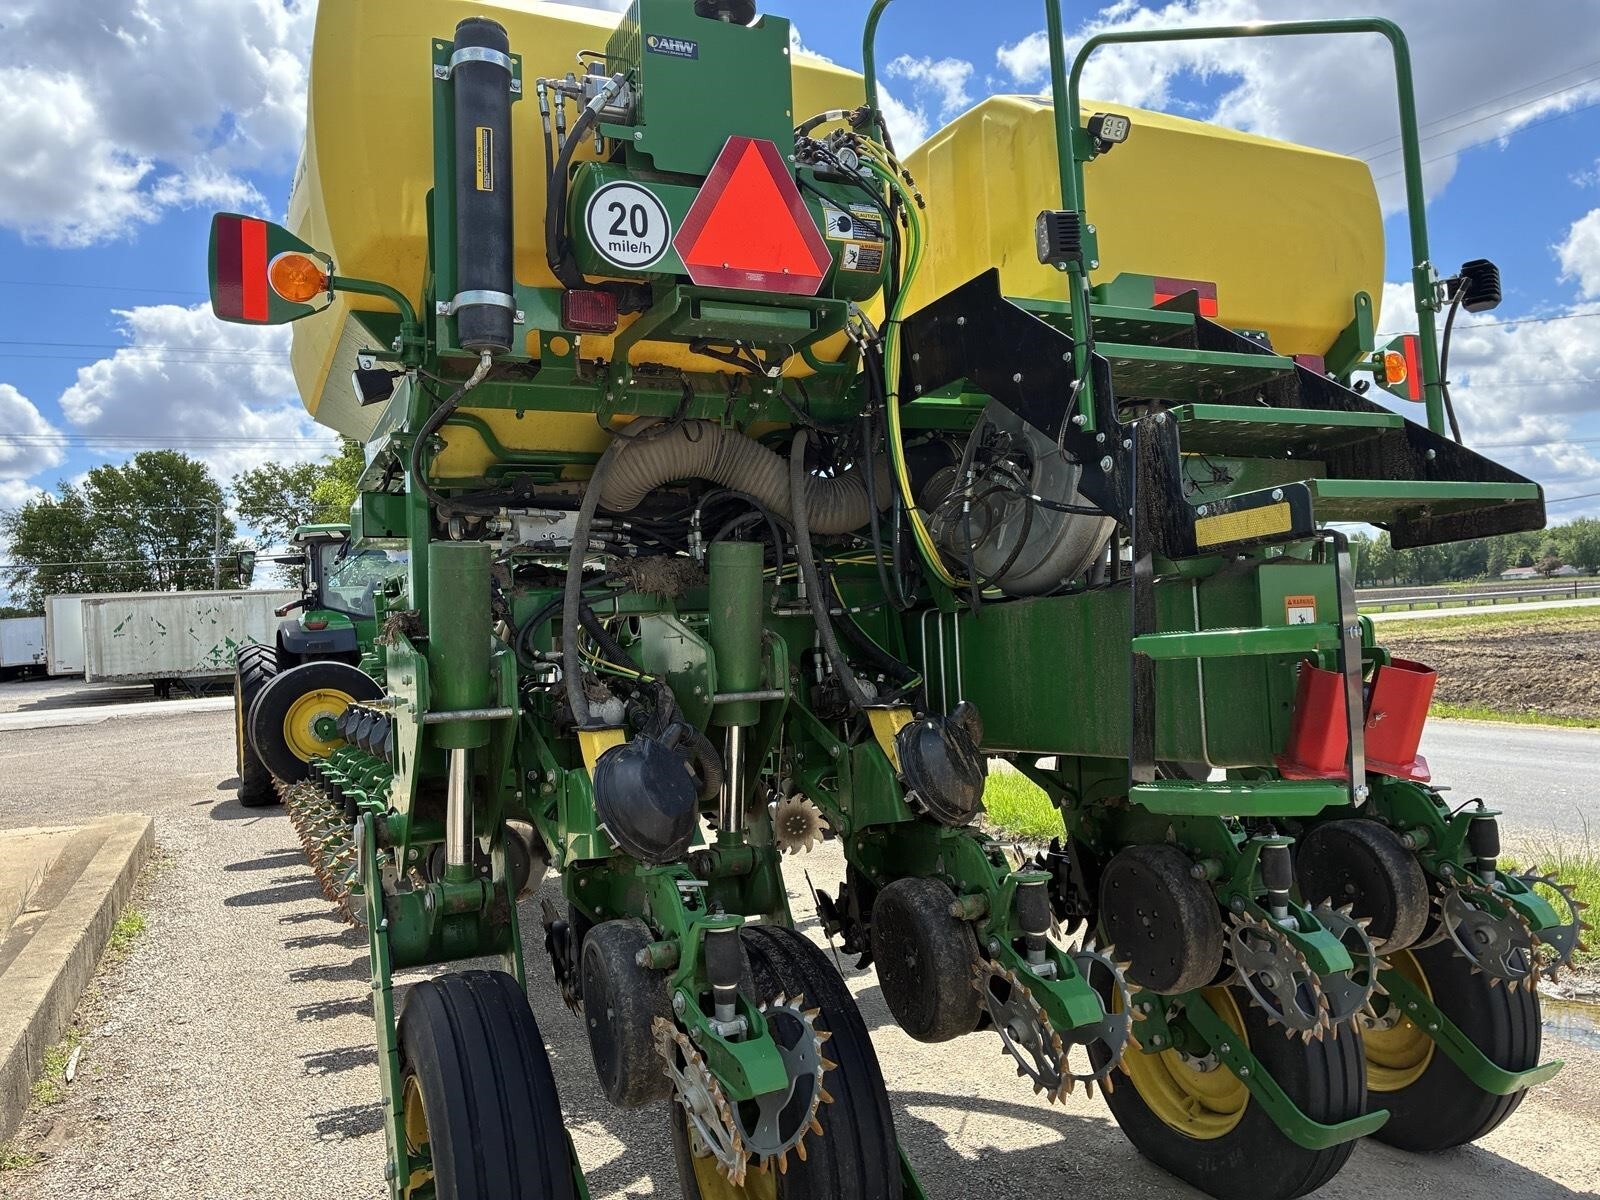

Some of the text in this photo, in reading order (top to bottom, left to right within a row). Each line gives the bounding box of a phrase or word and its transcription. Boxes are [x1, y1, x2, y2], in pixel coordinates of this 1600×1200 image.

[659, 38, 694, 53] AHW
[608, 201, 649, 239] 20
[608, 240, 652, 254] mile/h
